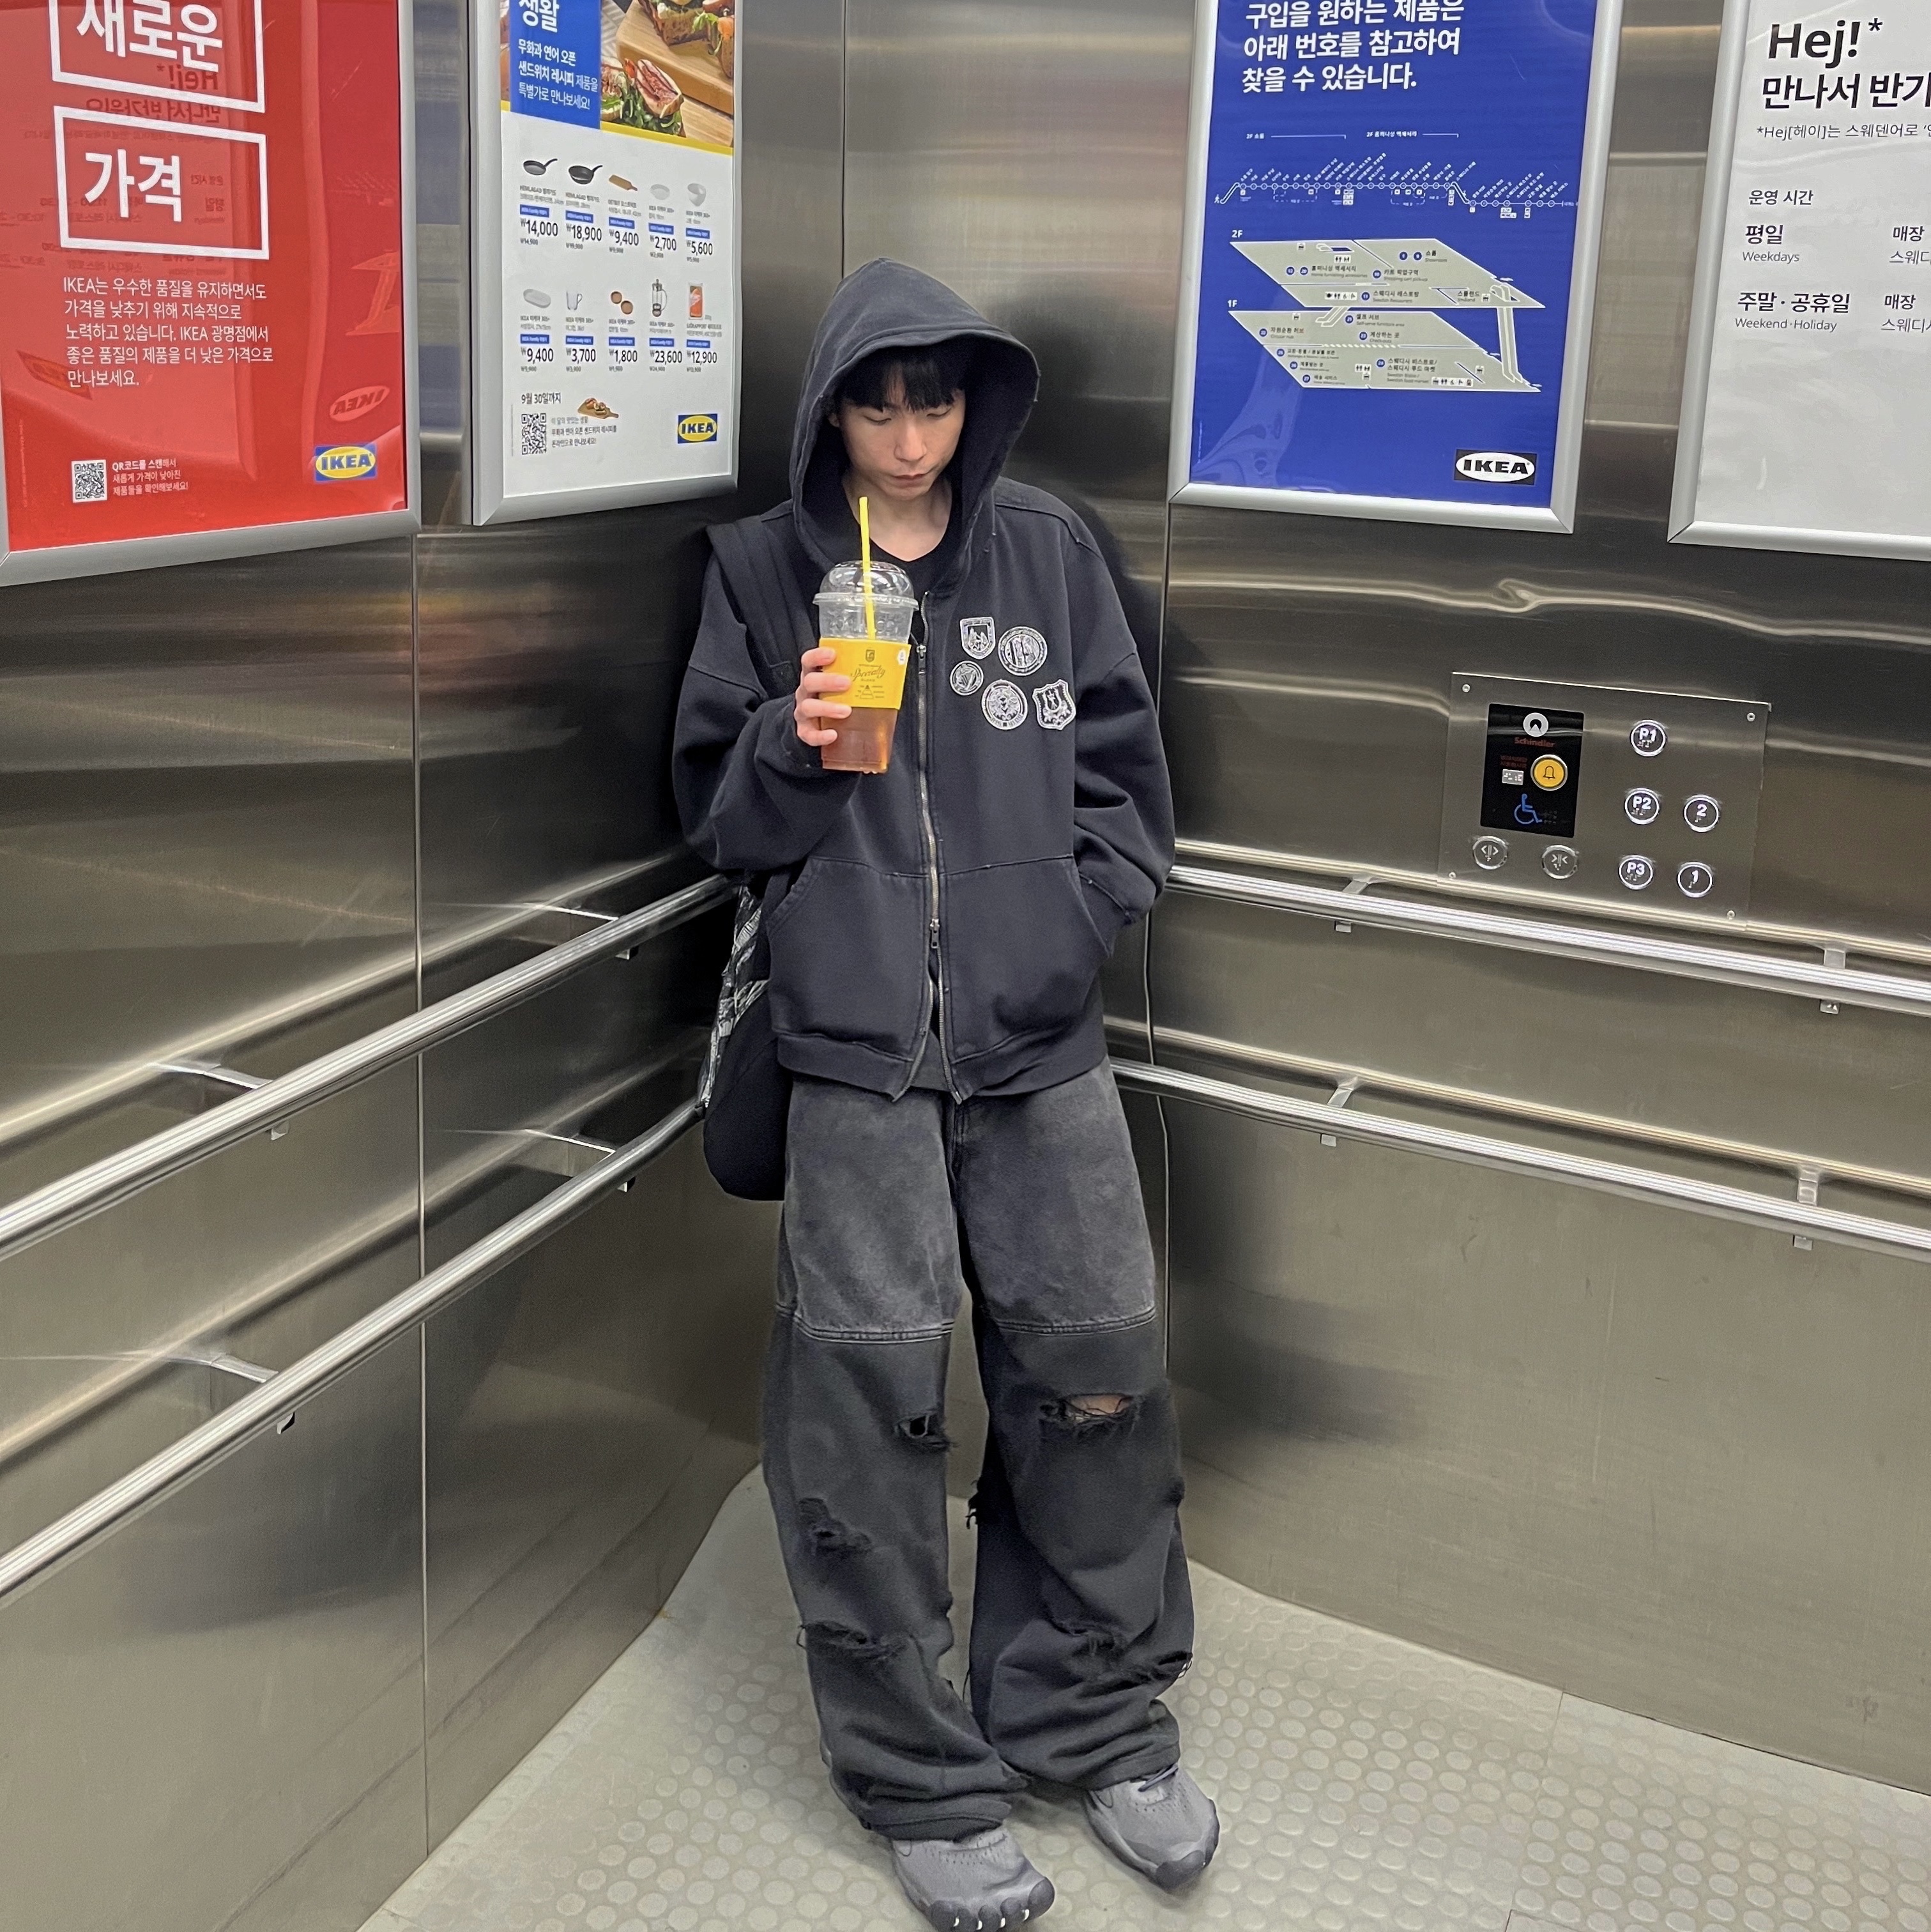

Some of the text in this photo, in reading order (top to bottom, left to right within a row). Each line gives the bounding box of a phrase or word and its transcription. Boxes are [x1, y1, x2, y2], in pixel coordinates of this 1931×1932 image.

[1246, 0, 1465, 29] 구입을 원하는 제품은
[76, 0, 222, 73] 새로운
[1244, 27, 1460, 61] 아래 번호를 참고하여
[519, 38, 576, 66] 무화과 연어 오픈
[519, 61, 598, 93] 샌드위치 레시피 제품을
[1242, 62, 1417, 93] 찾을 수 있습니다.
[519, 82, 590, 111] 특별가로 만나보세요!
[1762, 73, 1861, 109] 만나서
[1845, 123, 1918, 139] 스웨덴어로
[84, 149, 181, 222] 가격
[1748, 190, 1814, 206] 운영 시간
[1232, 229, 1243, 238] 2F
[1745, 224, 1783, 245] 평일
[1893, 226, 1925, 241] 매장
[1742, 251, 1800, 264] Weekdays
[63, 277, 267, 300] IKEA는 우수한 품질을 유지하면서도
[65, 300, 242, 320] 가격을 낮추기 위해 지속적으로
[1737, 292, 1851, 314] 주말 공휴일
[1884, 294, 1916, 310] 매장
[66, 323, 269, 342] 노력하고 있습니다. IKEA 광명점에서
[66, 346, 273, 365] 좋은 품질의 제품을 더 낮은 가격으로
[68, 369, 140, 388] 만나보세요.
[521, 392, 561, 404] 9월 30일까지
[681, 422, 715, 434] IKEA
[112, 458, 176, 472] QR코드를 스캔해서
[321, 454, 372, 470] IKEA
[1463, 459, 1529, 475] IKEA
[136, 471, 158, 482] 가격이
[160, 470, 181, 480] 낮아진
[1515, 737, 1555, 747] Schindler
[1638, 728, 1657, 741] P1
[1632, 797, 1652, 810] P2
[1696, 804, 1707, 817] 2
[1626, 862, 1645, 876] P3
[1691, 870, 1698, 882] 1
